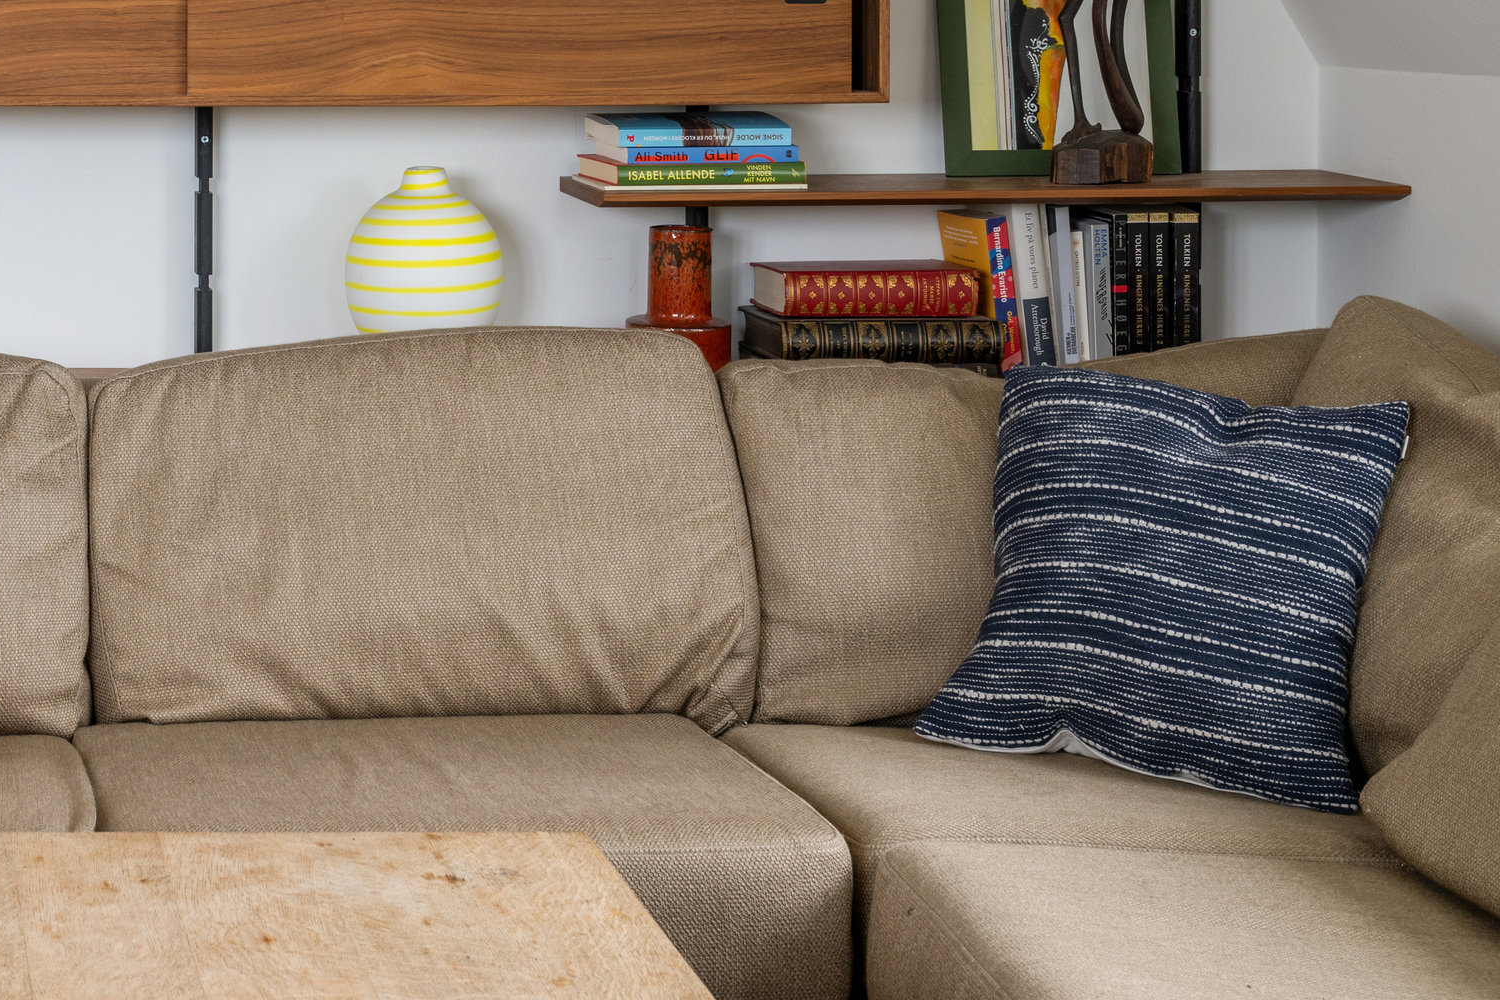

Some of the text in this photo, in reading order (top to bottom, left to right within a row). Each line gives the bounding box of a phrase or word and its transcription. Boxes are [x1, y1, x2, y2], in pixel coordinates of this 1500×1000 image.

[634, 148, 740, 162] Ali Smith GLIF
[628, 169, 715, 181] ISABEL ALLENDE
[992, 226, 1008, 303] Bernardine Evaristo
[1156, 274, 1164, 312] RINGENES
[1031, 304, 1044, 355] Attenborough
[1040, 317, 1050, 340] David
